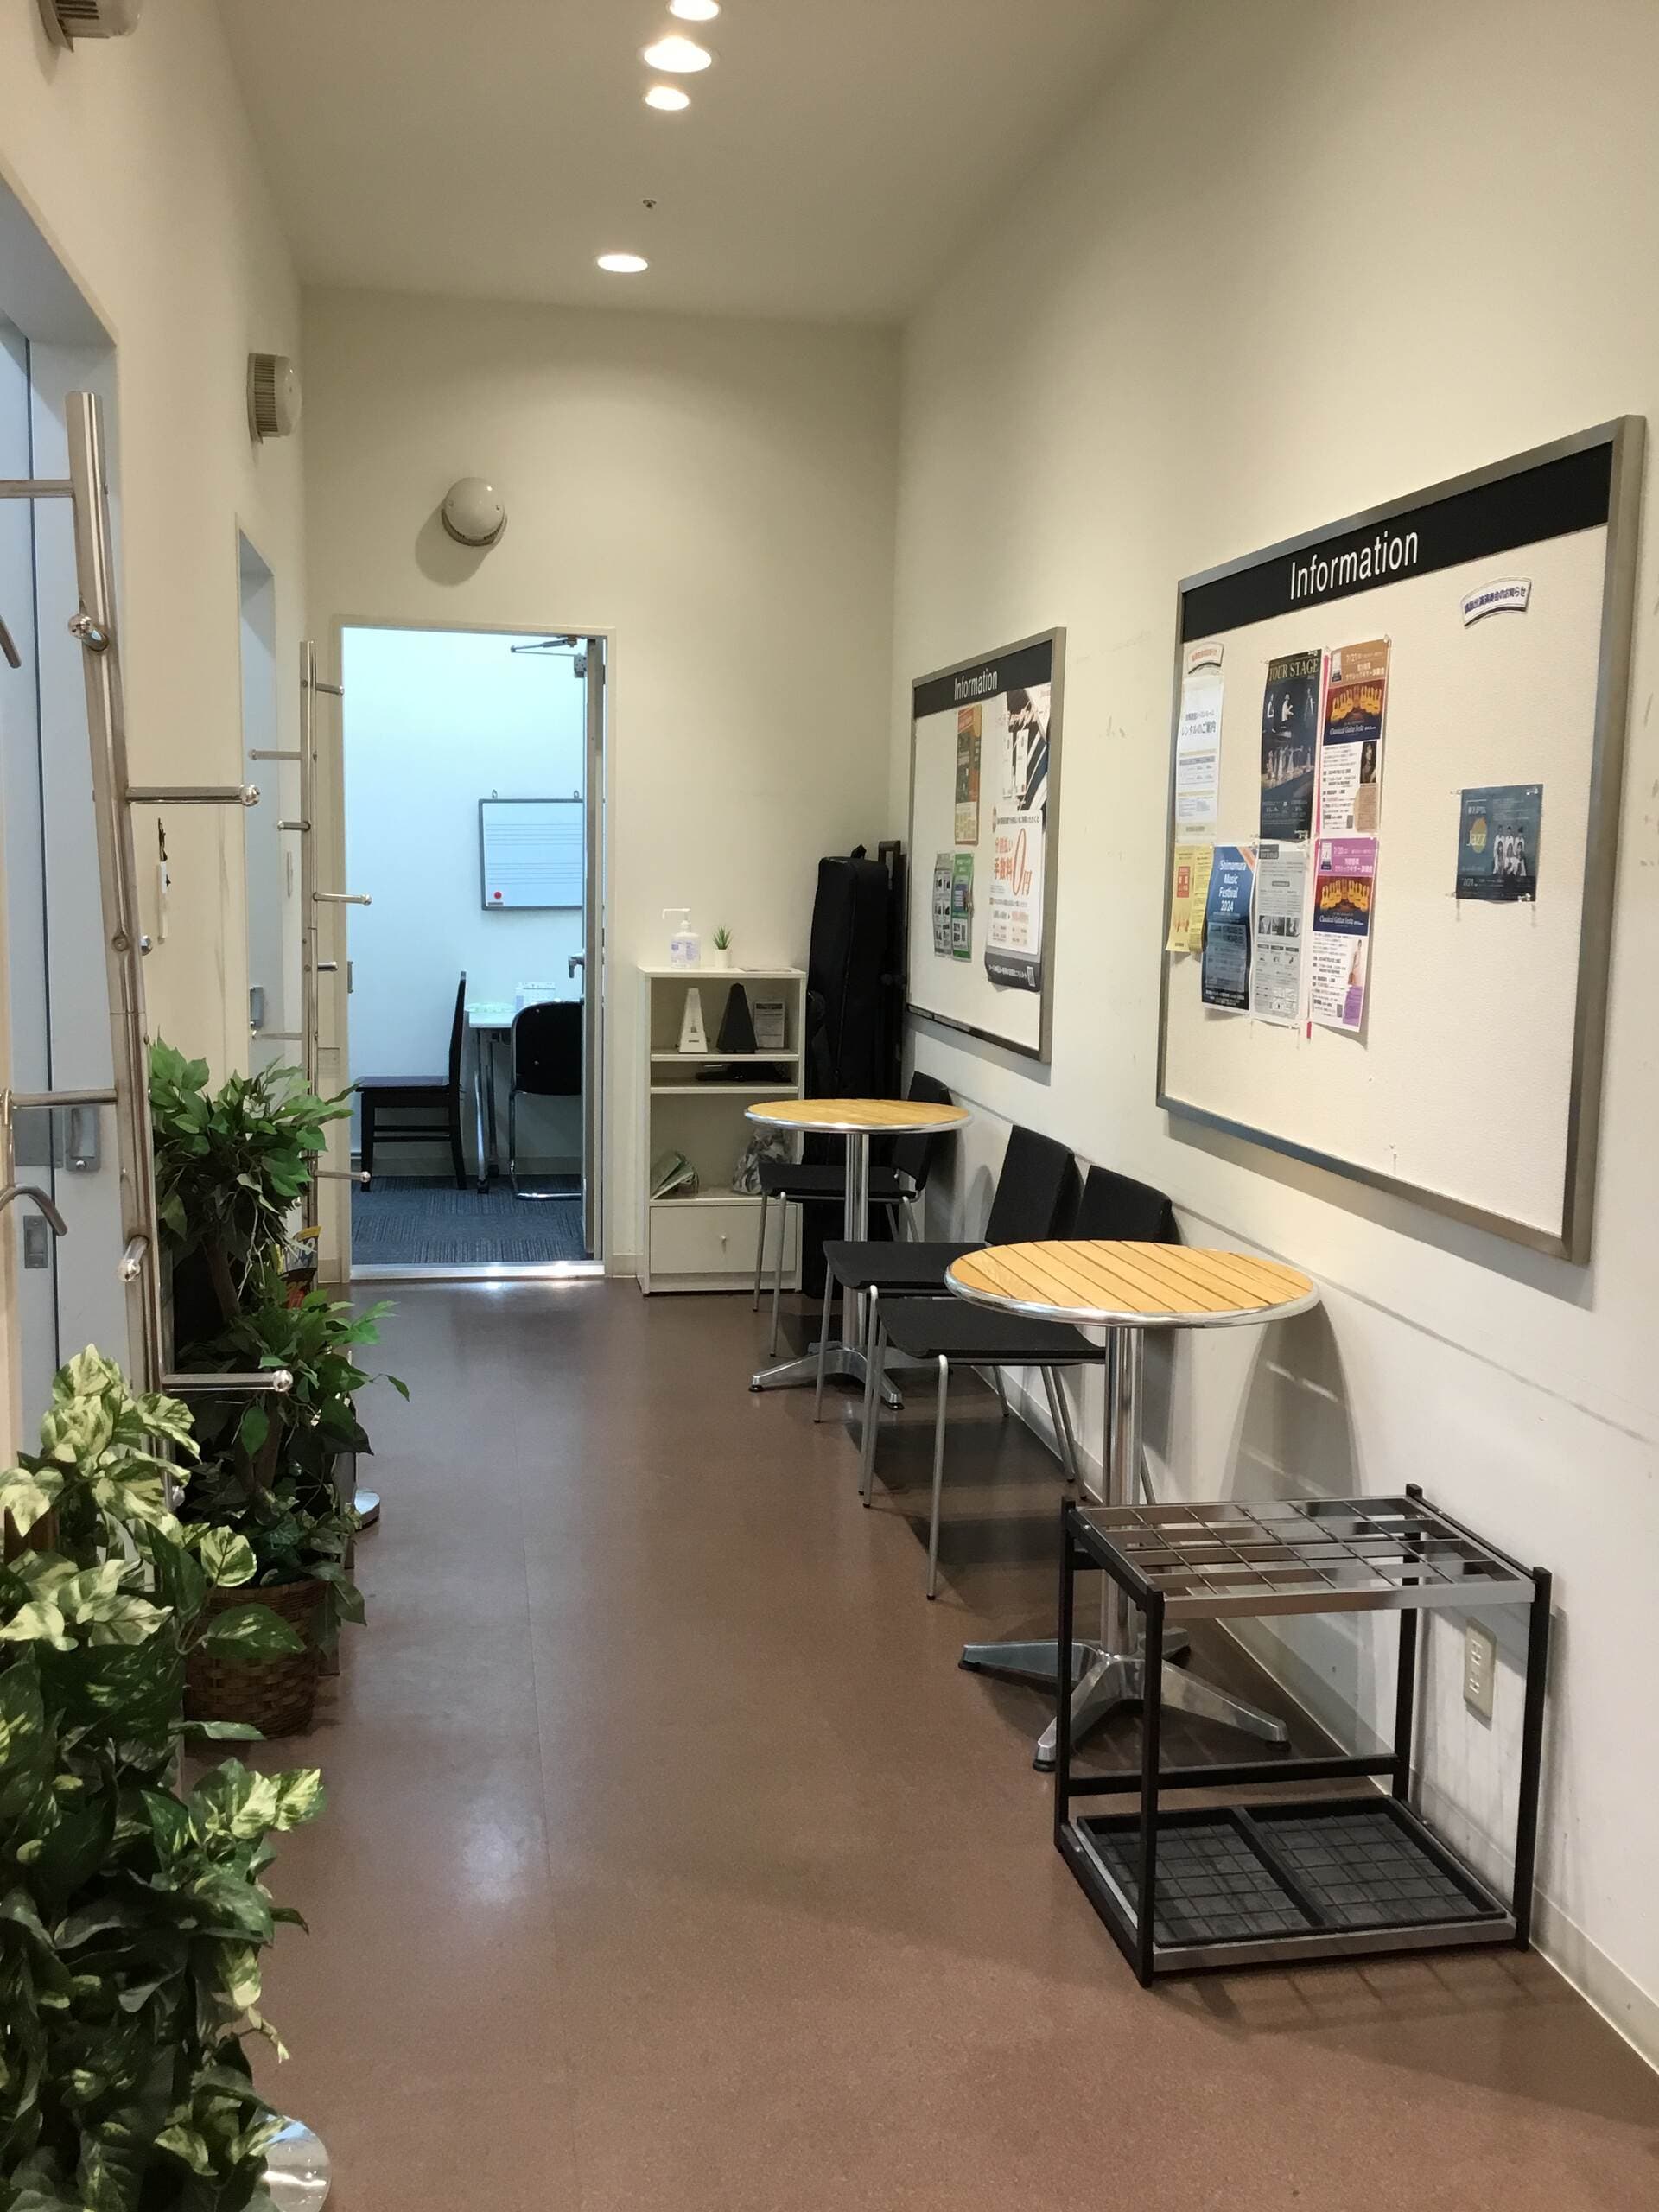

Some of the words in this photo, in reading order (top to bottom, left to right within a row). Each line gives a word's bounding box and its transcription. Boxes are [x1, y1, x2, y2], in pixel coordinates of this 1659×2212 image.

[1290, 531, 1419, 600] Information
[1289, 658, 1319, 677] STAGE
[954, 668, 998, 701] Information
[1223, 873, 1238, 884] Music
[1218, 886, 1239, 899] Festival
[1220, 899, 1234, 912] 2024
